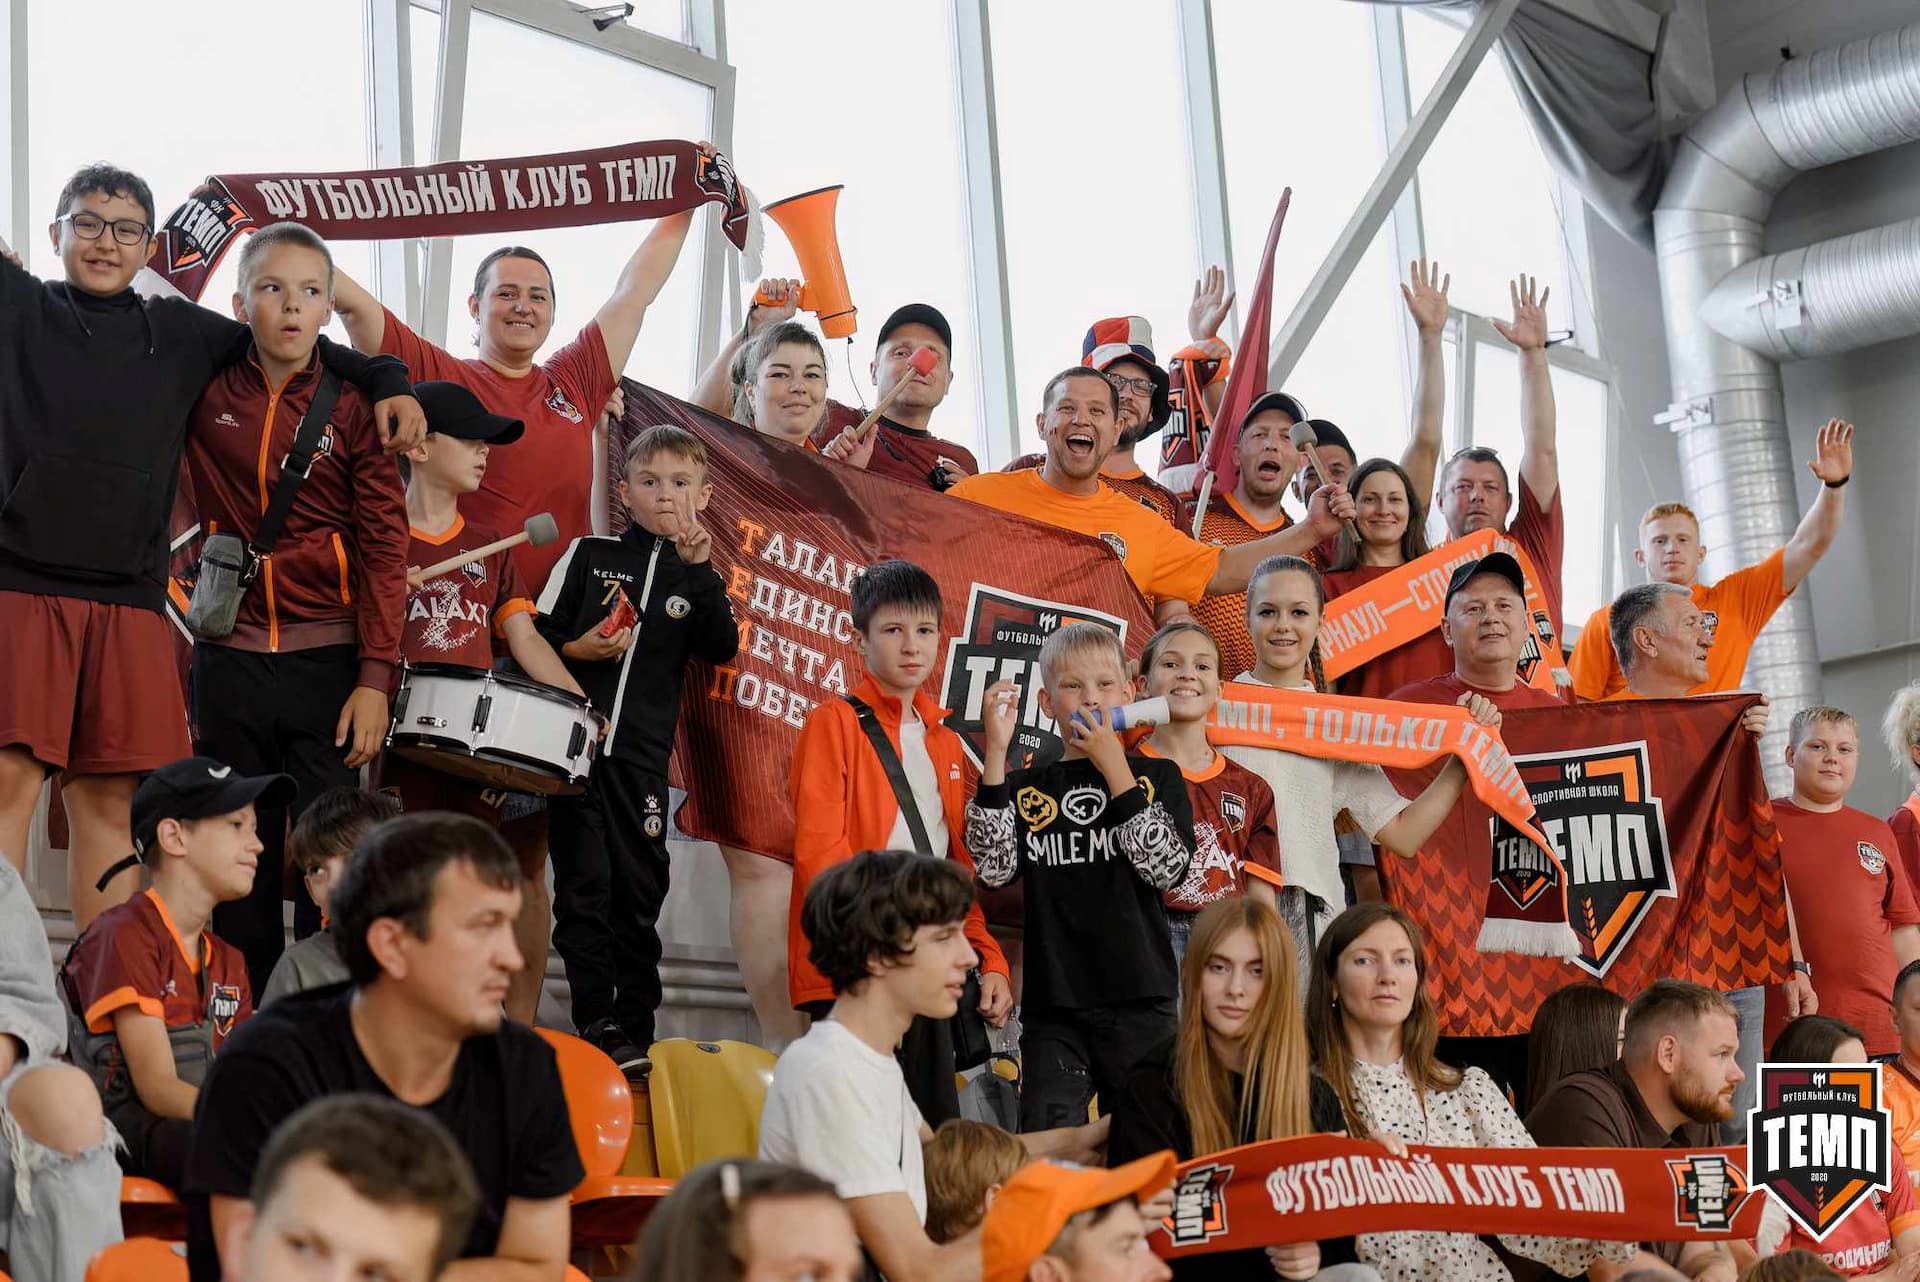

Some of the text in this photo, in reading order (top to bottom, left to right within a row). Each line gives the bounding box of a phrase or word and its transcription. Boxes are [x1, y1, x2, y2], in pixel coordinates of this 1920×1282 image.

[255, 164, 496, 220] ФУТБОЛЬНЫЙ
[500, 163, 592, 210] КЛУБ
[600, 154, 677, 203] ТЕМП
[174, 198, 227, 255] ТЕМП
[593, 567, 634, 582] KELME
[600, 580, 620, 605] 7
[404, 595, 489, 628] ALAXY
[707, 664, 819, 729] ПОБЕ
[1018, 733, 1041, 749] 2020
[1205, 699, 1285, 739] МП,
[1303, 706, 1448, 752] ТОЛЬКО
[1531, 784, 1619, 806] СПОРТИВНАЯ ШКОЛА
[1026, 831, 1086, 867] SMILE
[1176, 1171, 1213, 1238] ТЕМП
[1265, 1153, 1626, 1215] ФУТБОЛЬНЫЙ КЛУБ ТЕМП
[1693, 1160, 1726, 1225] ТЕМП
